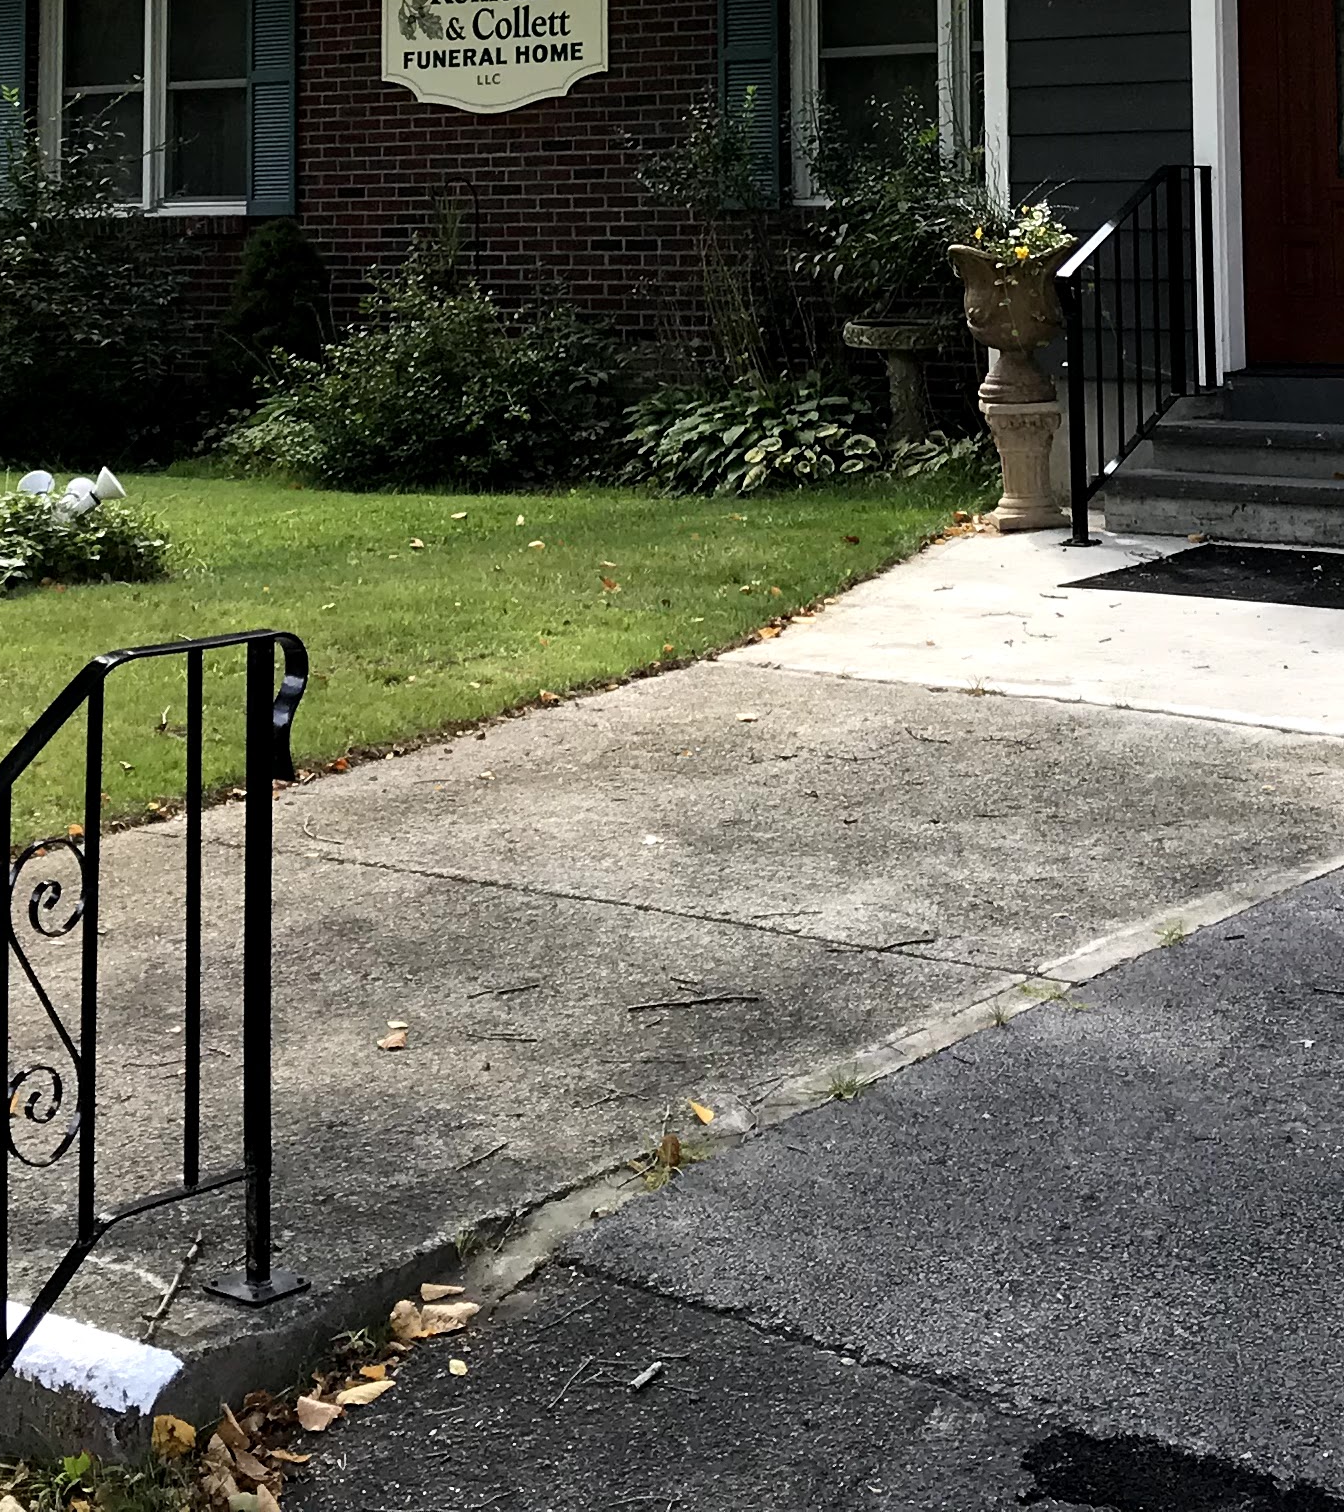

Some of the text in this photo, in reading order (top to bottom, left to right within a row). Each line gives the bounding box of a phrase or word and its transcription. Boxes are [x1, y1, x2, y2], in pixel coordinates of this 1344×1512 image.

[446, 5, 571, 41] & Collett
[403, 42, 583, 69] FUNERAL HOME
[477, 73, 501, 85] LLC
